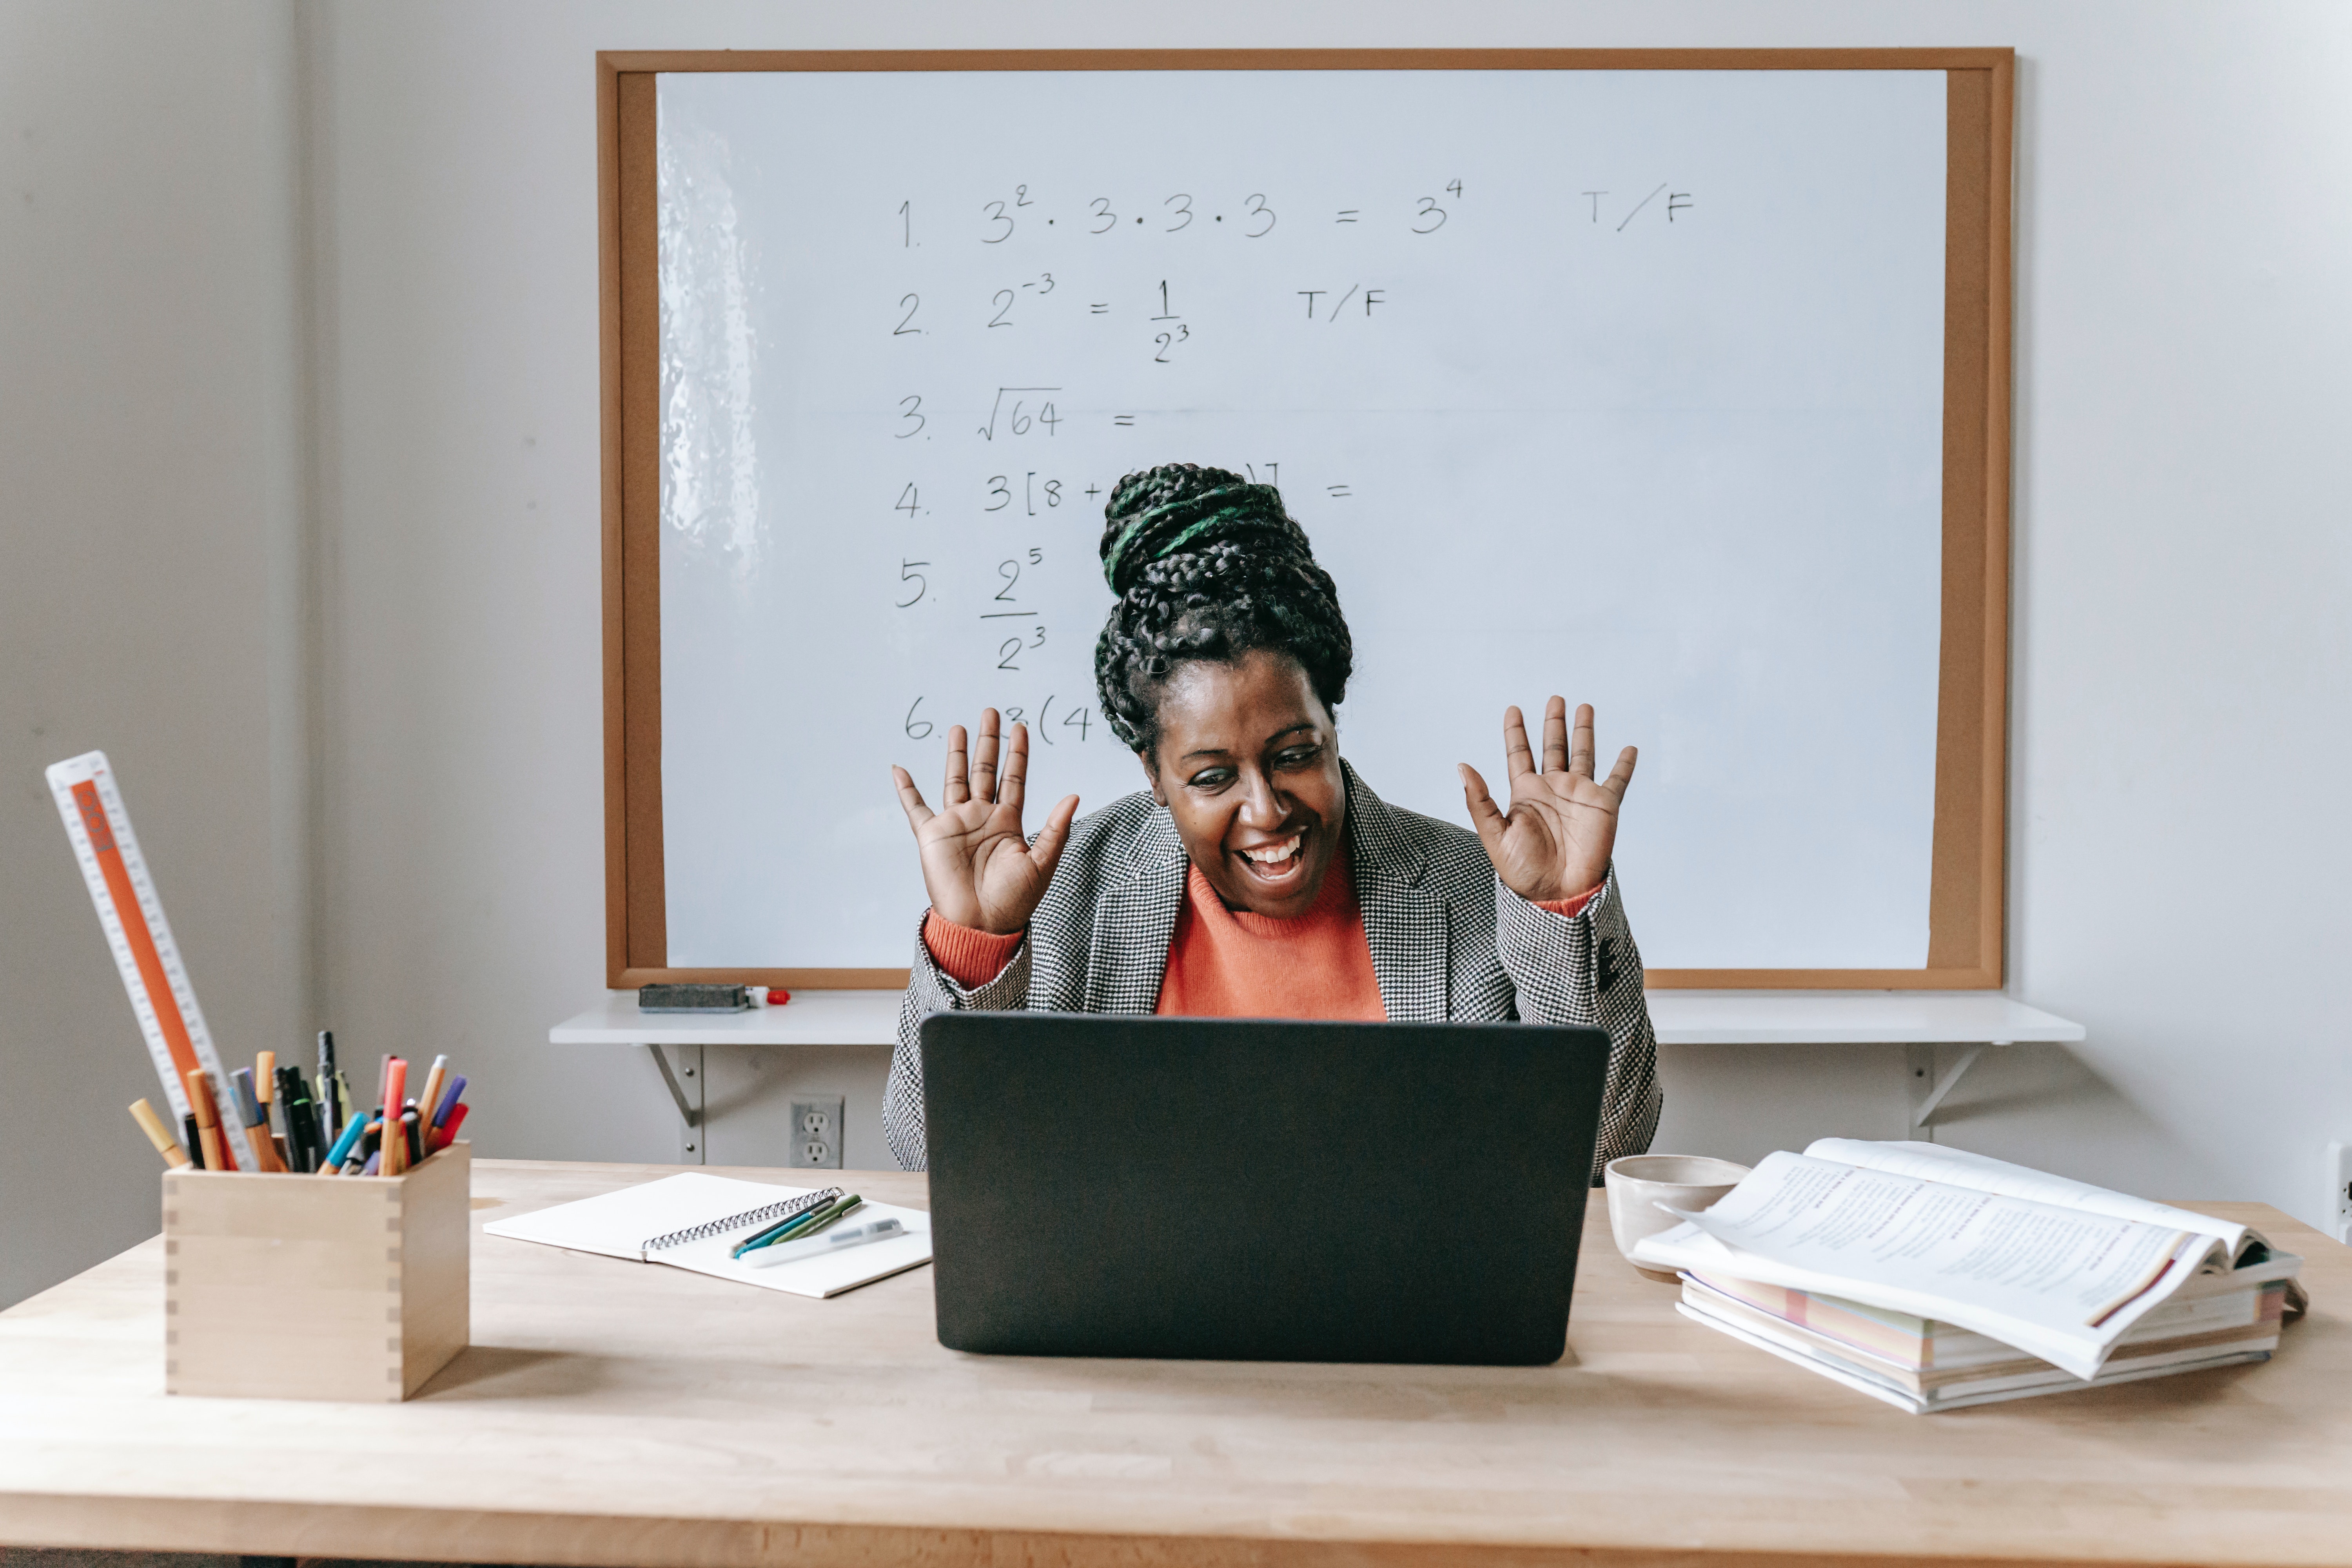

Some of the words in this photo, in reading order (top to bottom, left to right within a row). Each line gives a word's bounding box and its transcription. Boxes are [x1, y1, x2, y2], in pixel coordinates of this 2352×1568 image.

[898, 200, 920, 248] 1.
[1089, 197, 1117, 234] 3
[1164, 193, 1193, 233] 3
[1244, 193, 1276, 238] 3
[893, 292, 930, 336] 2.
[894, 394, 931, 440] 3.
[894, 481, 930, 519] 4.
[895, 557, 936, 609] 5.
[904, 695, 943, 740] 6.
